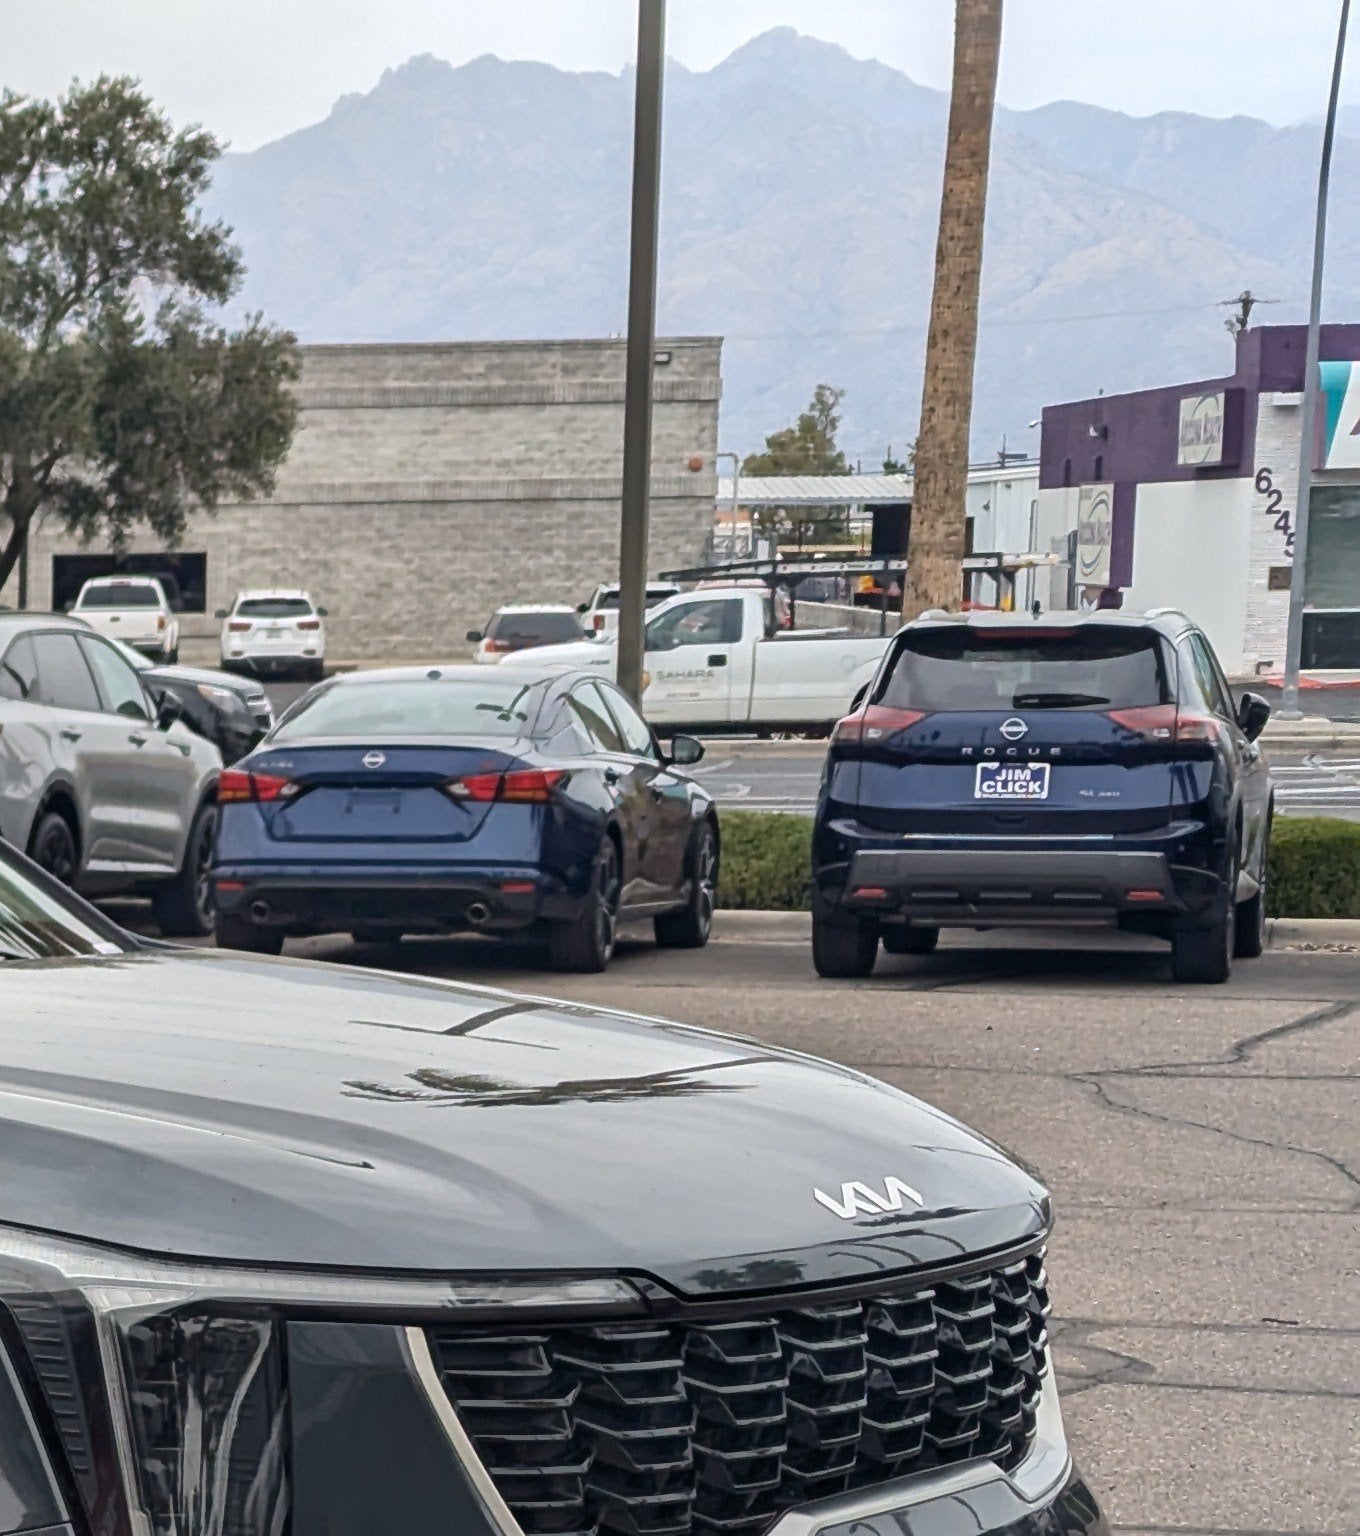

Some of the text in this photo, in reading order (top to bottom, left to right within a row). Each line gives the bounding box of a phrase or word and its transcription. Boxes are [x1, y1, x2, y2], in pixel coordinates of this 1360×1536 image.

[961, 747, 1061, 756] ROGUE
[995, 768, 1031, 781] JIM
[982, 781, 1041, 793] CLICK
[813, 1176, 923, 1220] KIA
